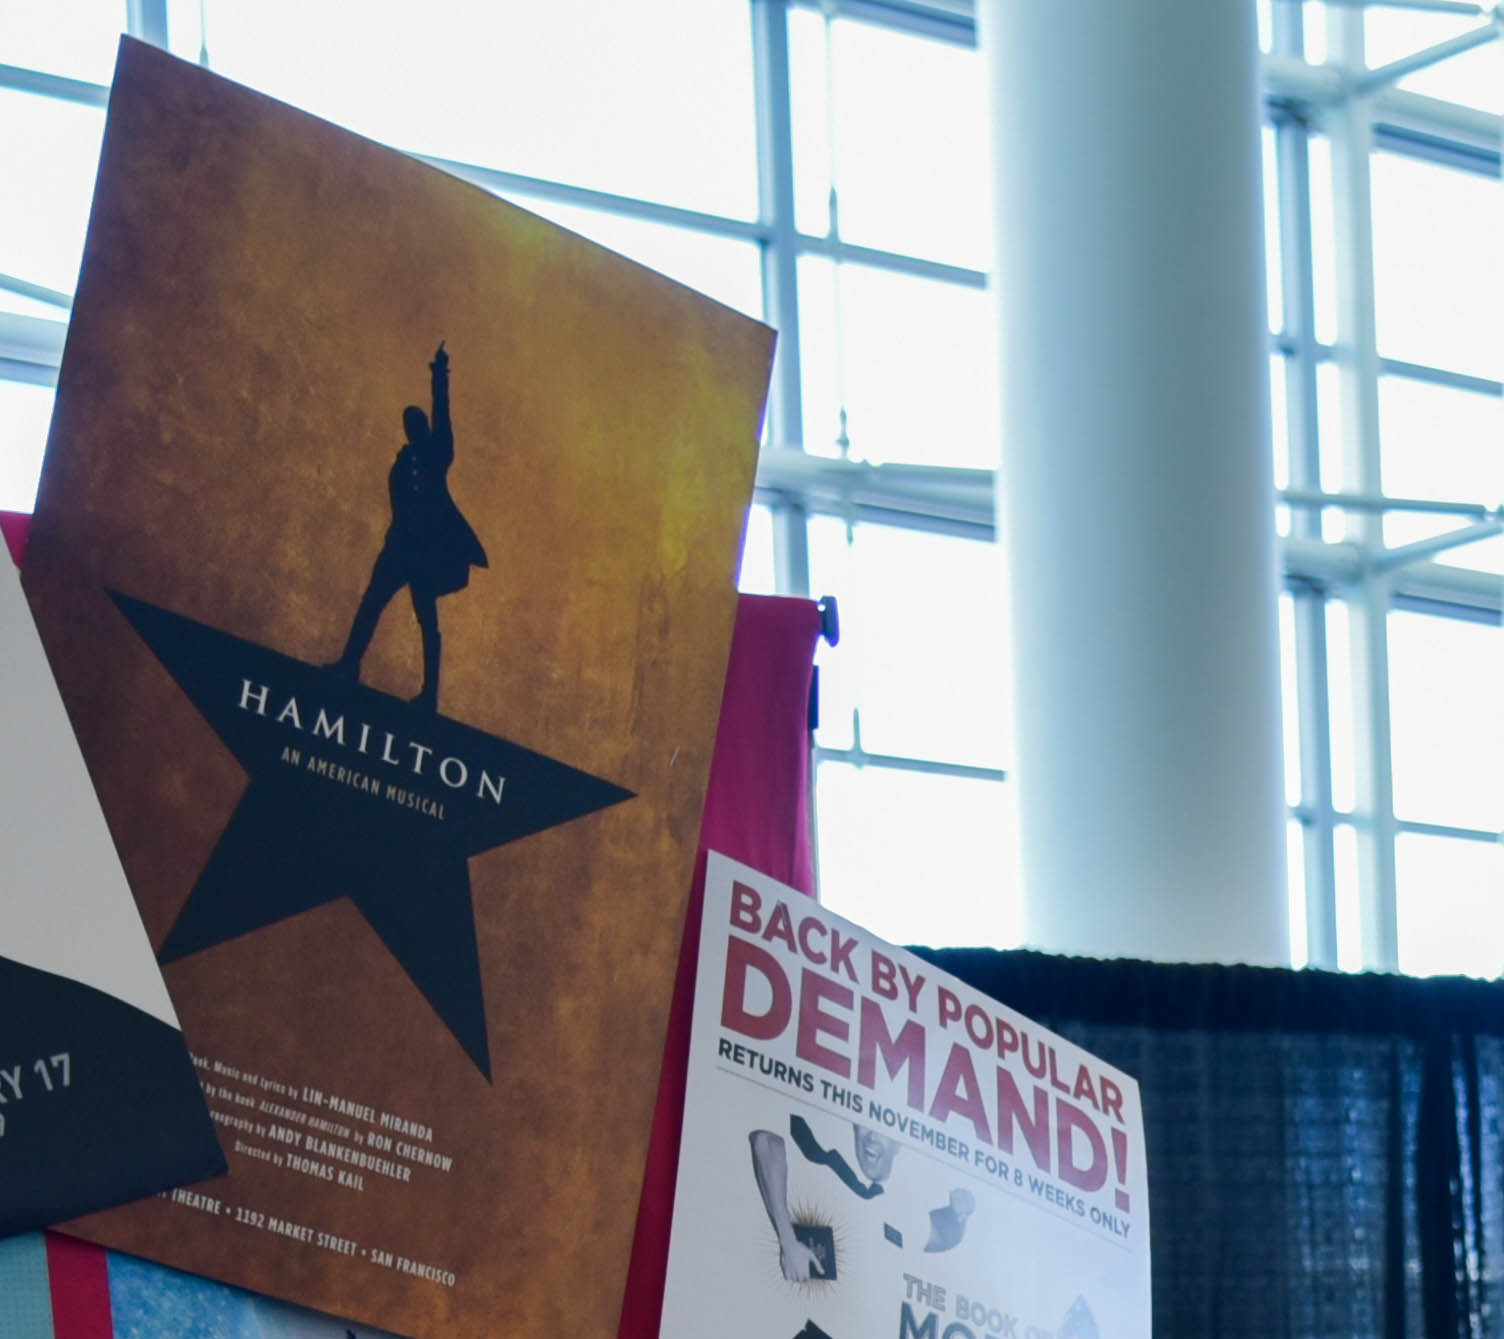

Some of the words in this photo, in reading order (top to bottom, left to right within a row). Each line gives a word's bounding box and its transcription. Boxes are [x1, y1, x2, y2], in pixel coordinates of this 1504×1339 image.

[238, 679, 506, 804] HAMILTON
[281, 746, 300, 765] AN
[306, 756, 380, 796] AMERICAN
[386, 784, 446, 820] MUSICAL
[731, 880, 860, 984] BACK
[871, 953, 924, 1004] BY
[938, 986, 1124, 1124] POPULAR
[32, 1054, 70, 1097] 17
[721, 935, 1130, 1214] DEMAND!
[302, 1087, 375, 1123] LIN-MANUEL
[380, 1112, 433, 1142] MIRANDA
[718, 1039, 815, 1092] RETURNS
[820, 1080, 863, 1112] THIS
[869, 1102, 970, 1162] NOVEMBER
[974, 1148, 1010, 1180] FOR
[1013, 1167, 1024, 1187] 8
[1027, 1173, 1085, 1216] WEEKS
[1089, 1206, 1131, 1239] ONLY
[235, 1208, 265, 1228] 1192
[268, 1217, 313, 1242] MARKET
[317, 1232, 357, 1256] STREET
[371, 1249, 393, 1267] SAN
[396, 1257, 455, 1286] FRANCISCO
[902, 1272, 947, 1312] THE
[955, 1294, 1019, 1339] BOOK
